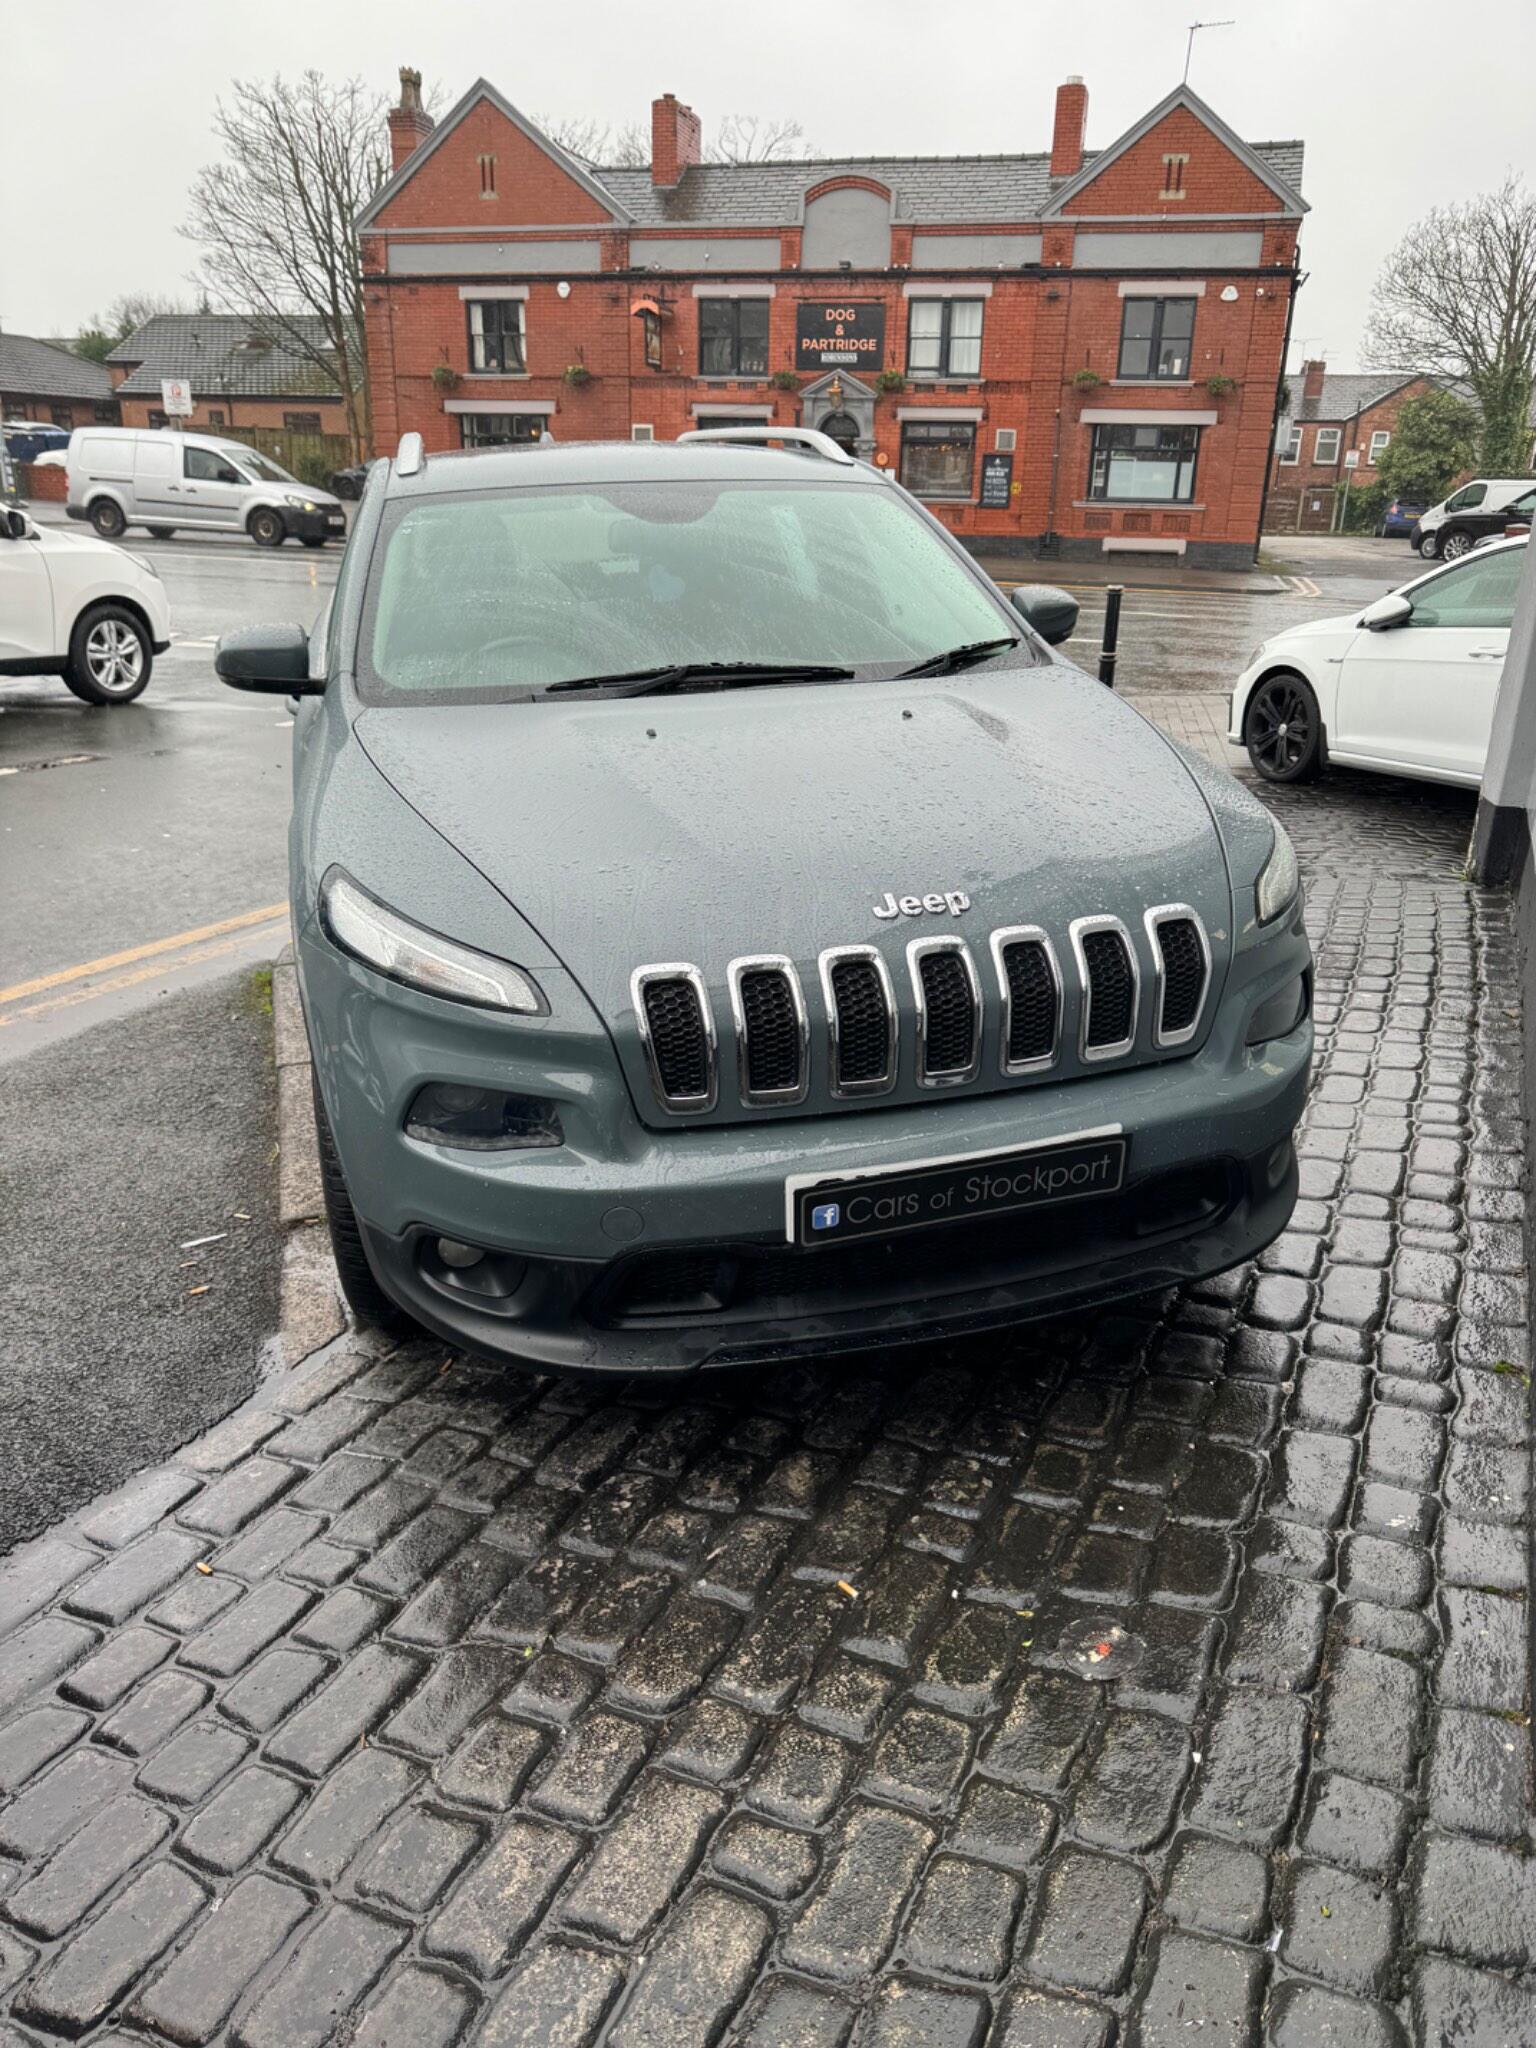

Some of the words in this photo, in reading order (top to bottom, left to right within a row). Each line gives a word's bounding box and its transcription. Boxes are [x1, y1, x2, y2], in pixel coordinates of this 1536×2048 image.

[825, 309, 856, 321] DOG
[835, 323, 845, 336] &
[802, 338, 877, 351] PARTRIDGE
[872, 891, 971, 919] Jeep
[846, 1188, 920, 1224] Cars
[929, 1186, 954, 1209] of
[963, 1154, 1112, 1204] Stockport
